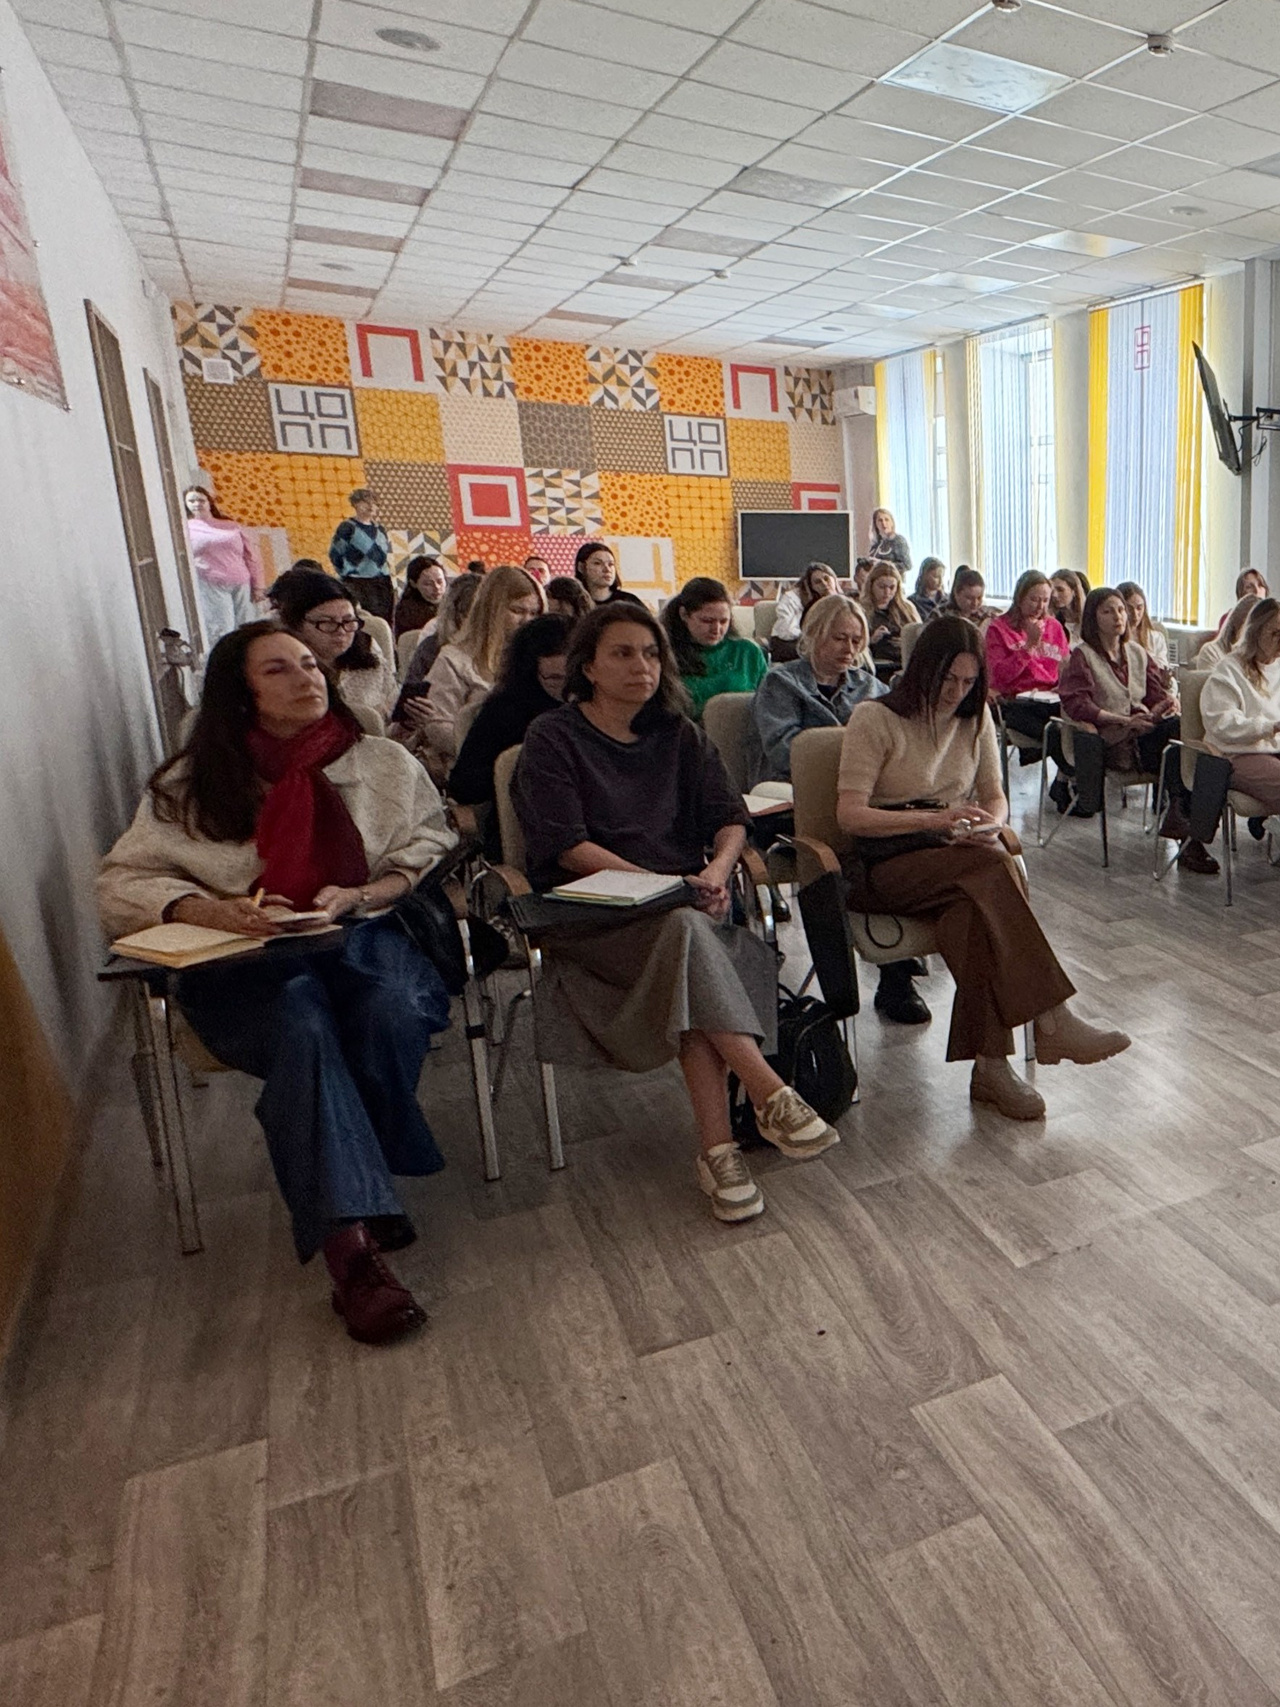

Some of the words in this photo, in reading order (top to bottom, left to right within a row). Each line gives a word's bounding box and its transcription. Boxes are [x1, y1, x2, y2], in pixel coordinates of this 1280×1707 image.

[275, 388, 347, 420] ЦО
[279, 421, 352, 449] ПП
[668, 418, 721, 446] ЦО
[671, 447, 723, 472] ПП
